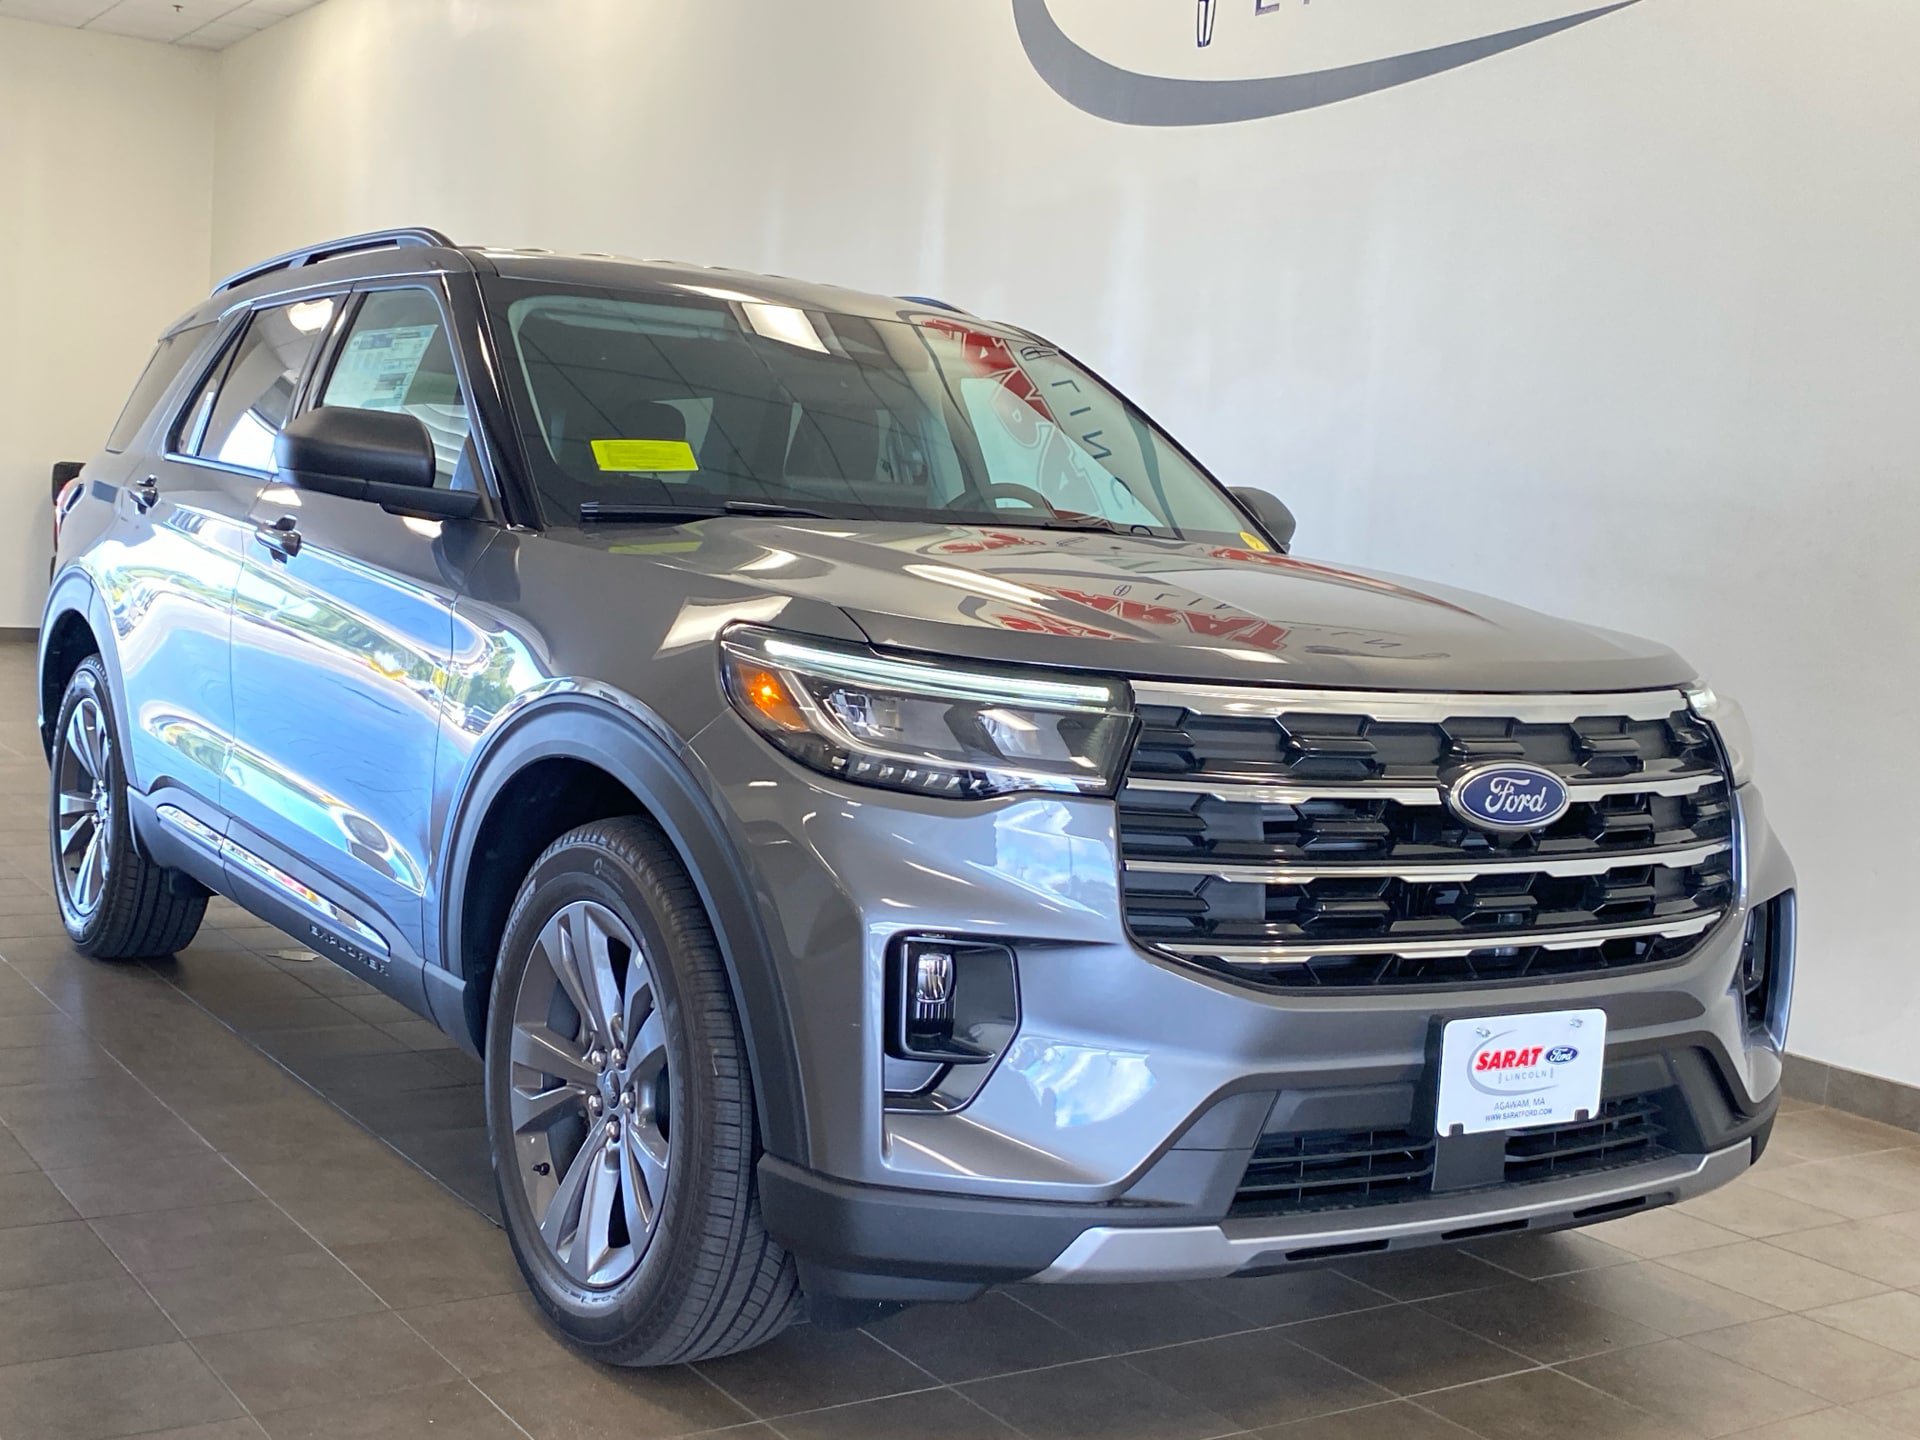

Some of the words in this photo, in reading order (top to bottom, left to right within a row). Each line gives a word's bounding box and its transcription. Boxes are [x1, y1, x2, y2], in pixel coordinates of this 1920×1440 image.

[1485, 777, 1548, 813] Ford
[1475, 1047, 1545, 1071] SARAT
[1548, 1047, 1575, 1063] Ford
[1505, 1071, 1547, 1082] LINCOLN
[1532, 1097, 1545, 1106] MA
[1485, 1108, 1553, 1121] WWW.SARATFORD.COM
